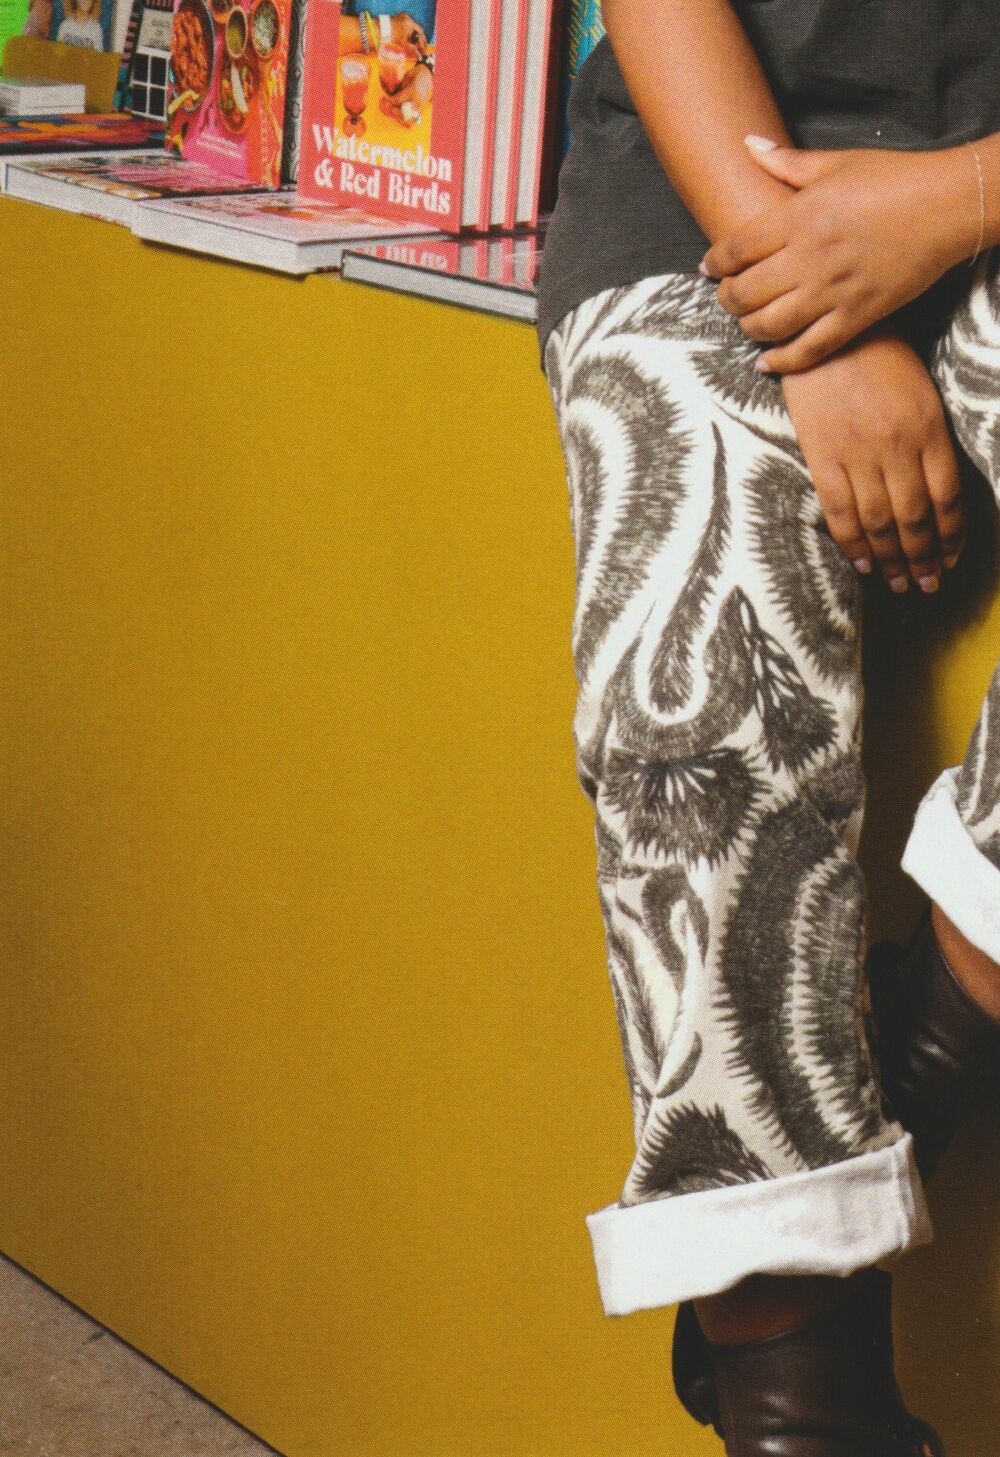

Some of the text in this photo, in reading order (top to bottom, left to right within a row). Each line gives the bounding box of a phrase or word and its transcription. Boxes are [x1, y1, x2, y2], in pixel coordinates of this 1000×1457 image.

[312, 124, 452, 182] Watermelon
[314, 158, 451, 215] & Red Birds
